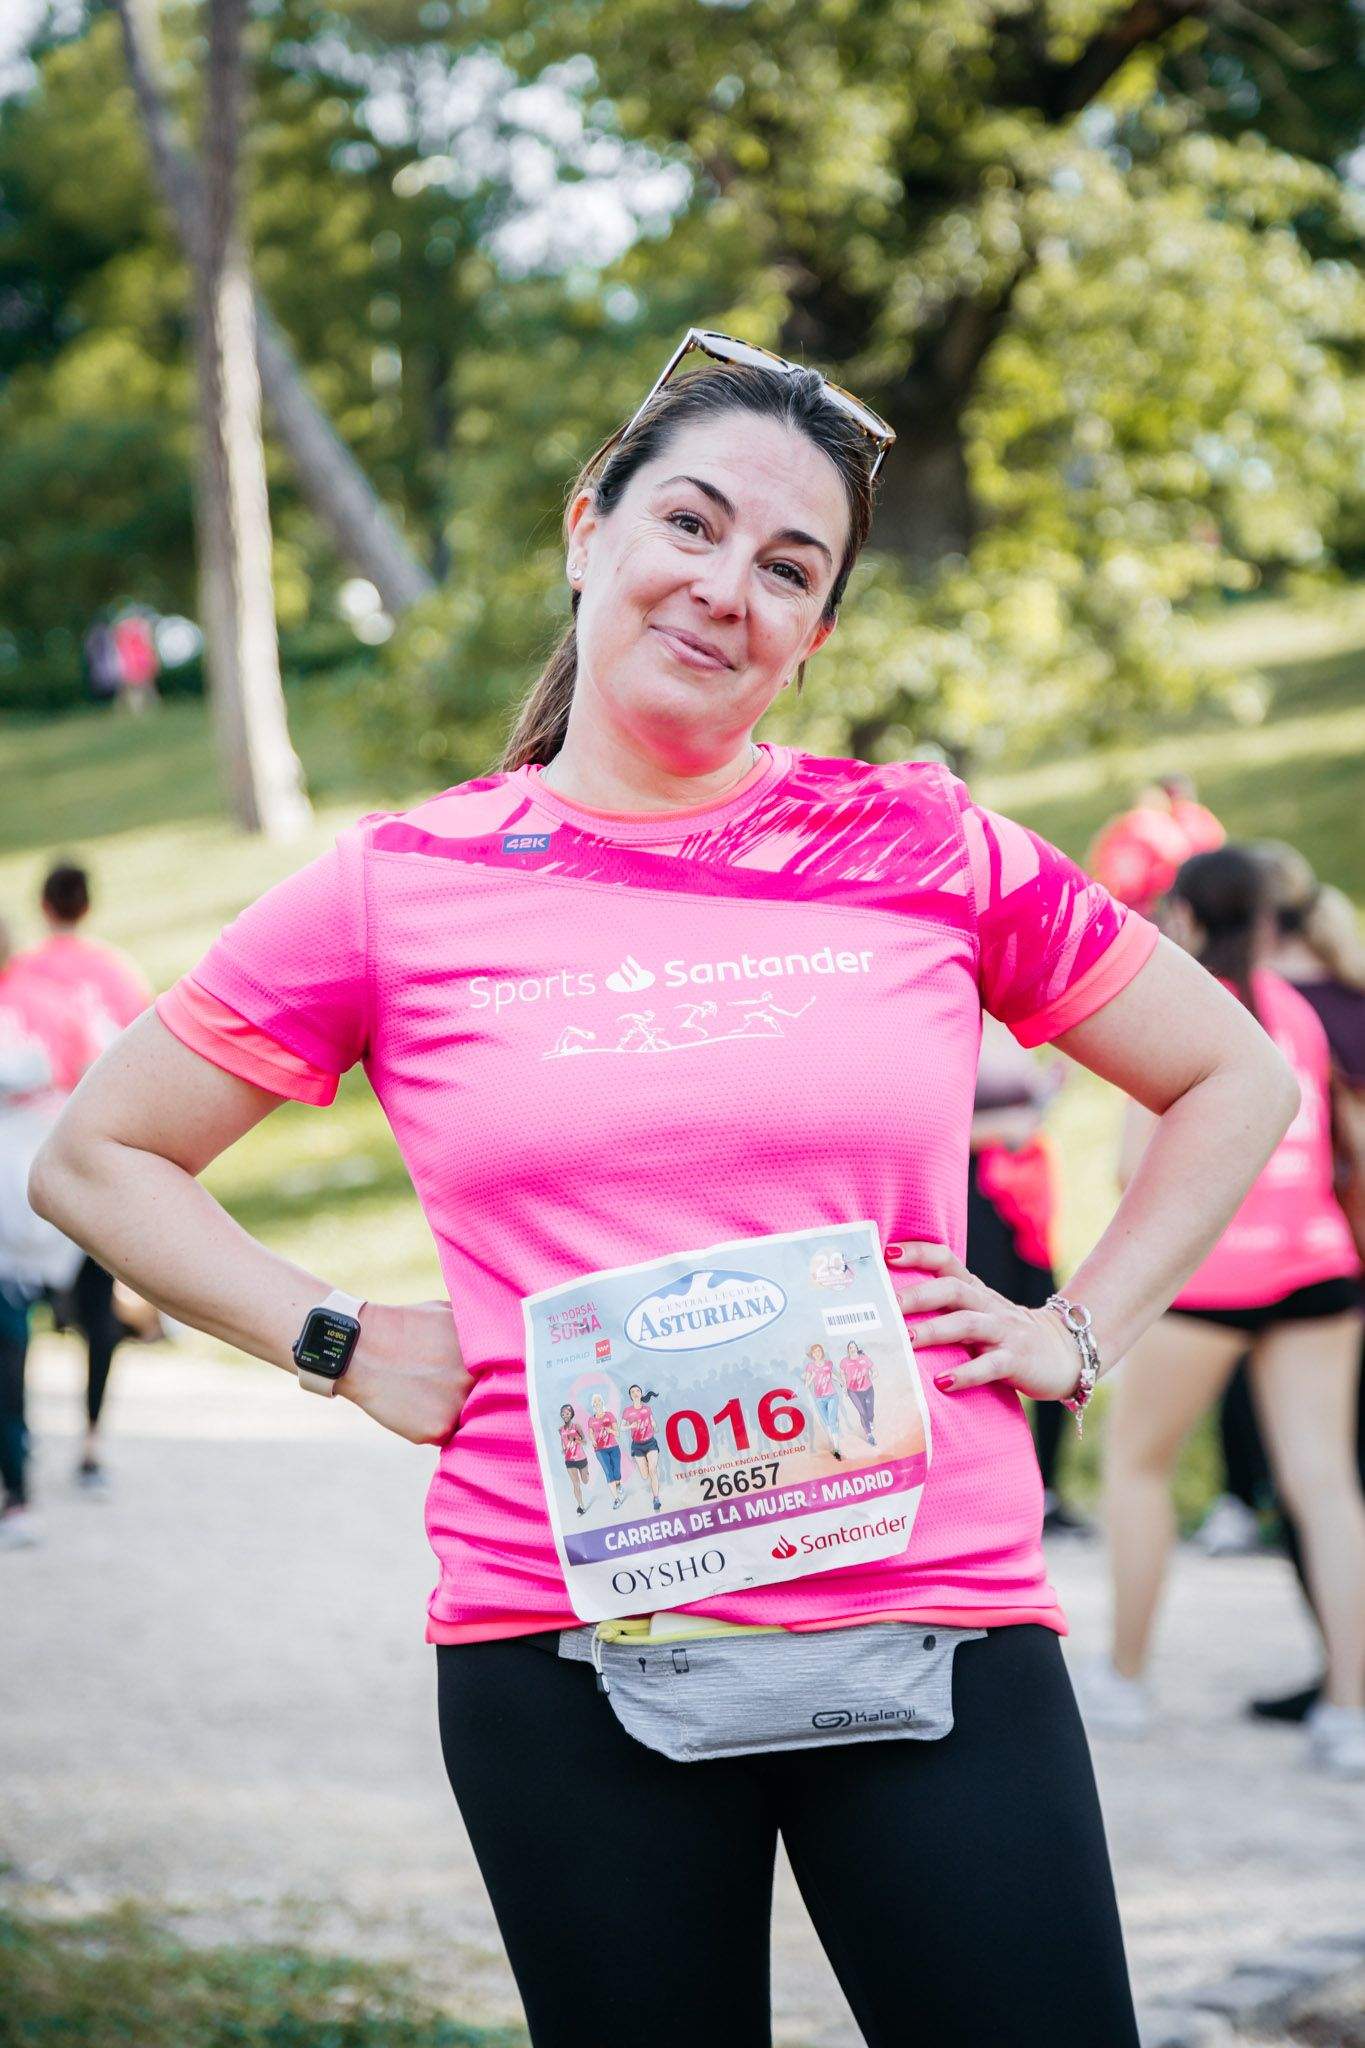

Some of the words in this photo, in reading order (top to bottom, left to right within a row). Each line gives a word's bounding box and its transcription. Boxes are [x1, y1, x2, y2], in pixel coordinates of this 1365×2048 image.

[506, 836, 548, 849] 42K
[468, 968, 597, 1015] Sports
[663, 946, 875, 989] Santander
[550, 1313, 603, 1345] SUMA
[561, 1301, 598, 1321] DORSAL
[637, 1294, 778, 1342] ASTURIANA
[665, 1387, 807, 1464] 016
[699, 1461, 781, 1502] 26657
[717, 1456, 761, 1471] VIOLENCIA
[761, 1452, 773, 1461] DE
[604, 1517, 687, 1552] CARRERA
[688, 1510, 715, 1532] DE
[717, 1505, 742, 1526] LA
[744, 1490, 808, 1520] MUJER
[821, 1469, 894, 1503] MADRID
[800, 1514, 908, 1555] Santander
[611, 1549, 726, 1595] OYSHO
[854, 1705, 917, 1723] Kalenji
